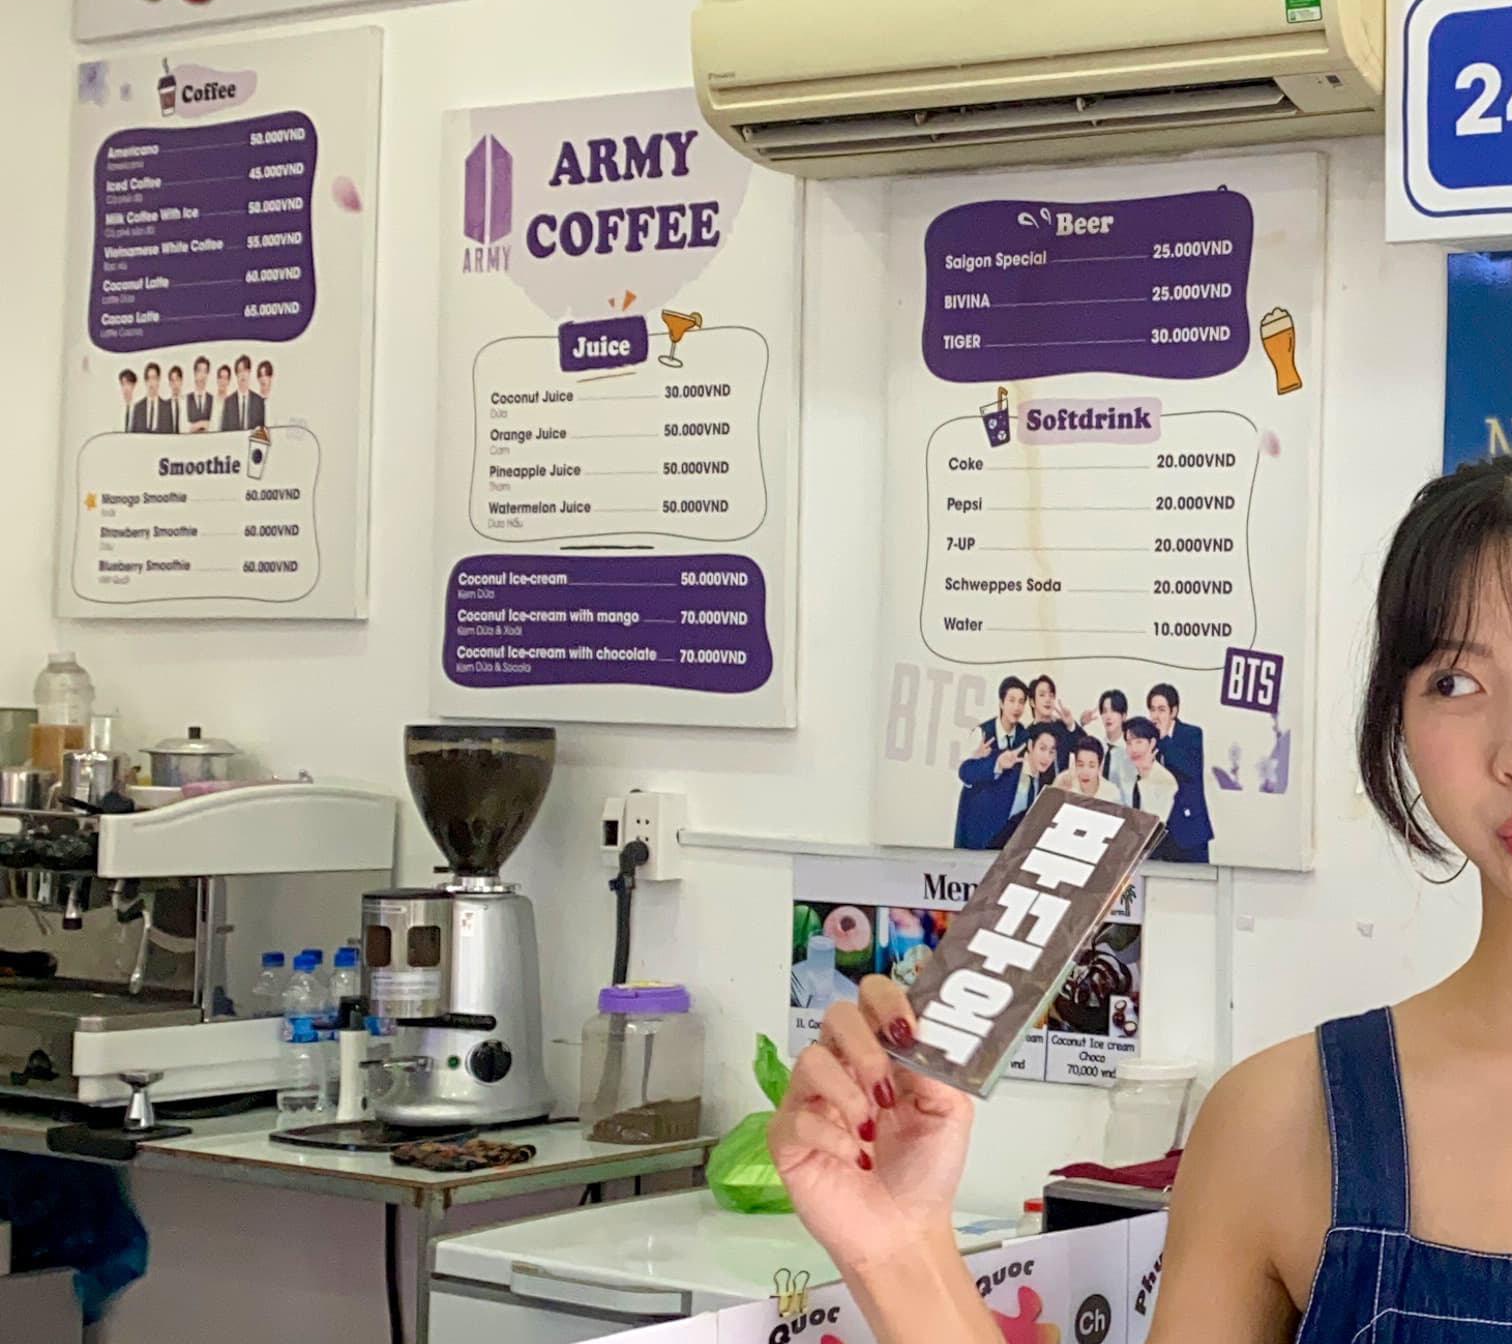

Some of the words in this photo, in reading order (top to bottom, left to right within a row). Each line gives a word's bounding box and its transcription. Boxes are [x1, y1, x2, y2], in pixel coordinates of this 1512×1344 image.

[182, 83, 236, 103] Coffee
[108, 145, 159, 158] Americano
[250, 128, 305, 145] 50.000VND
[549, 130, 698, 187] ARMY
[107, 181, 128, 192] Iced
[130, 177, 161, 190] Coffee
[249, 163, 304, 179] 45.000VND
[105, 212, 125, 225] Milk
[127, 210, 159, 224] Coffee
[183, 207, 198, 219] Ice
[248, 197, 303, 214] 50.000VND
[526, 201, 720, 259] COFFEE
[1056, 212, 1114, 237] Beer
[104, 244, 159, 258] Vietnamese
[162, 242, 188, 253] White
[191, 239, 224, 251] Coffee
[247, 232, 302, 248] 55.000VND
[462, 246, 512, 274] ARMY
[945, 254, 992, 273] Saigon
[996, 251, 1047, 273] Special
[1153, 240, 1233, 259] 25.000VND
[103, 278, 144, 292] Coconut
[145, 277, 169, 289] Latte
[246, 267, 301, 283] 60.000VND
[944, 293, 990, 309] BIVINA
[1152, 283, 1232, 302] 25.000VND
[101, 313, 134, 325] Cacao
[136, 311, 160, 323] Latte
[244, 302, 299, 317] 65.000VND
[572, 336, 630, 357] Juice
[944, 334, 981, 350] TIGER
[1151, 326, 1231, 344] 30.000VND
[491, 391, 539, 404] Coconut
[542, 390, 574, 403] Juice
[664, 384, 731, 399] 30.000VND
[1026, 408, 1152, 432] Softdrink
[490, 429, 532, 443] Orange
[536, 428, 567, 440] Juice
[664, 423, 730, 437] 50.000VND
[159, 456, 240, 476] Smoothie
[489, 465, 546, 480] Pineapple
[550, 464, 581, 476] Juice
[663, 461, 729, 475] 50.000VND
[948, 457, 984, 471] Coke
[1156, 454, 1236, 468] 20.000VND
[143, 492, 187, 504] Smoothie
[246, 489, 300, 501] 60.000VND
[947, 497, 982, 513] Pepsi
[1155, 496, 1235, 511] 20.000VND
[488, 502, 558, 514] Watermelon
[561, 502, 591, 513] Juice
[662, 500, 728, 513] 50.000VND
[100, 527, 150, 539] Strawberry
[153, 526, 198, 537] Smoothie
[245, 525, 299, 537] 60.000VND
[946, 538, 976, 551] 7-UP
[1154, 538, 1234, 553] 20.000VND
[99, 560, 143, 573] Blueberry
[146, 560, 190, 571] Smoothie
[243, 561, 298, 572] 60.000VND
[458, 572, 506, 586] Coconut
[681, 572, 748, 587] 50.000VND
[944, 577, 1022, 594] Schweppes
[1026, 577, 1062, 592] Soda
[1153, 580, 1233, 595] 20.000VND
[458, 609, 506, 623] Coconut
[570, 610, 594, 623] with
[597, 613, 639, 627] mango
[680, 611, 748, 625] 70.000VND
[944, 617, 983, 632] Water
[1153, 622, 1232, 637] 10.000VND
[457, 646, 505, 659] Coconut
[569, 647, 593, 660] with
[596, 647, 656, 661] chocolate
[679, 649, 747, 664] 70.000VND
[1227, 654, 1277, 706] BTS
[924, 873, 978, 902] Men
[1051, 1035, 1086, 1046] Coconut
[1090, 1038, 1104, 1049] Ice
[1107, 1042, 1135, 1052] cream
[1079, 1051, 1106, 1062] Choco
[1067, 1064, 1098, 1077] 70,000
[1101, 1069, 1117, 1078] vnd
[1078, 1311, 1107, 1336] Ch
